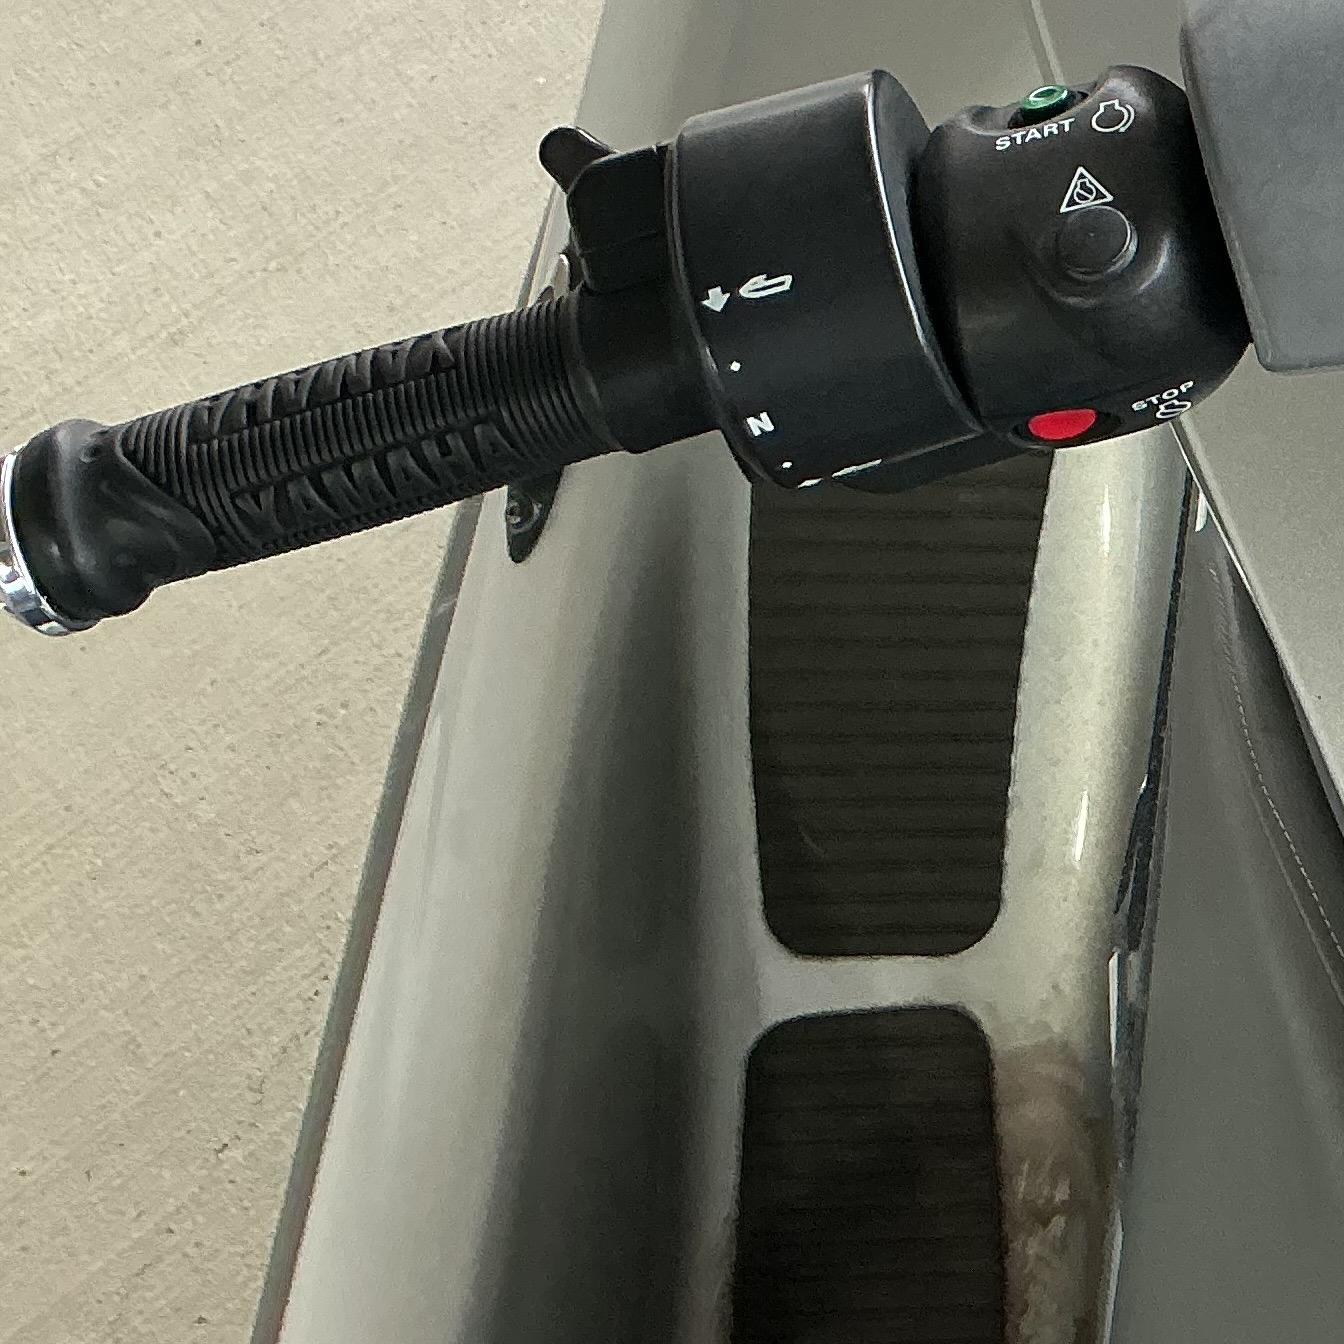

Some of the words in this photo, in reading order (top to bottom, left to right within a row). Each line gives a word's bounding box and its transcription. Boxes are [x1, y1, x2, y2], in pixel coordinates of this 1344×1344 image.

[995, 118, 1075, 151] START
[1131, 381, 1194, 412] STOP
[746, 411, 775, 437] N
